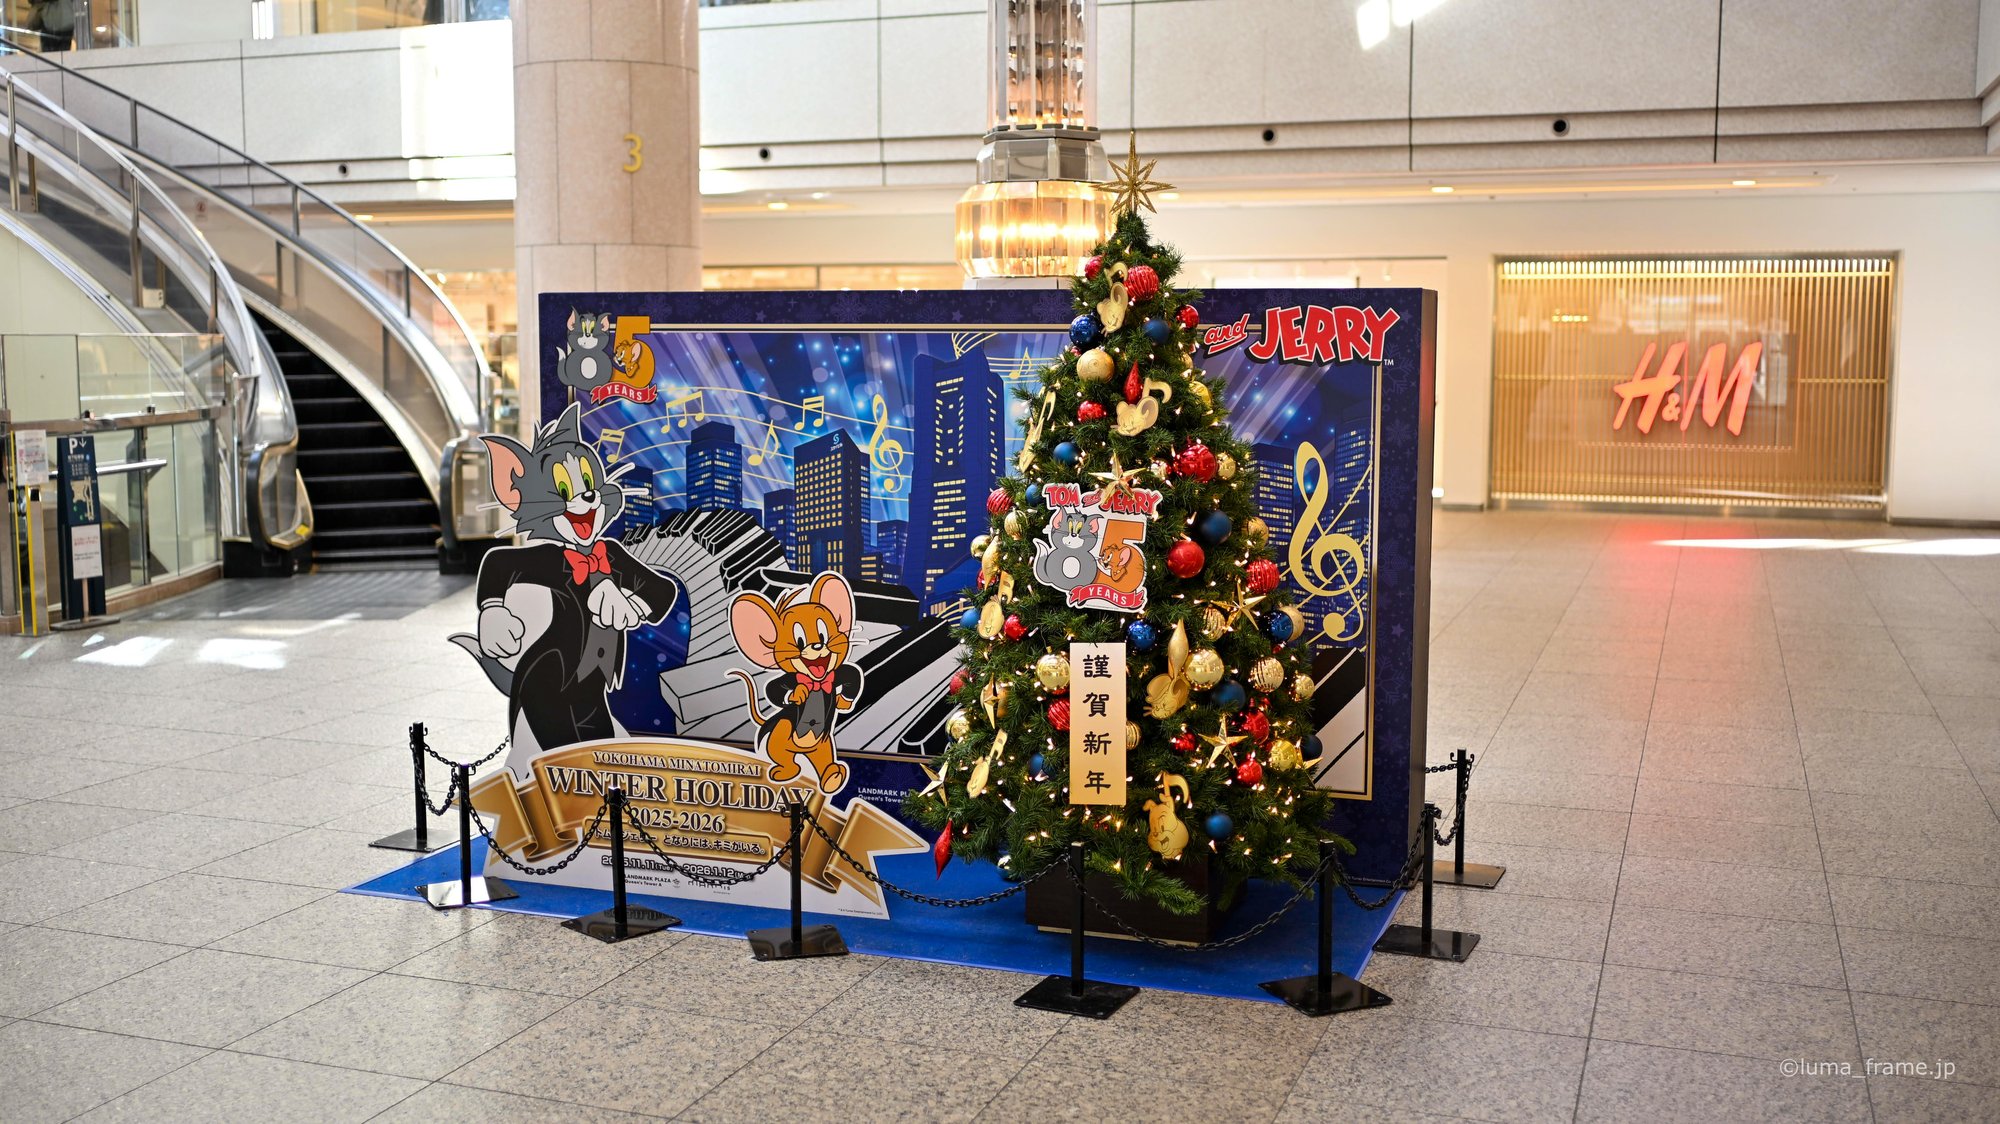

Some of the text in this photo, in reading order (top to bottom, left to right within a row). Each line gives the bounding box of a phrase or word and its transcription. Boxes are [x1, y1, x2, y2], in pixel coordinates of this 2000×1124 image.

[623, 133, 643, 172] 3
[1204, 313, 1250, 354] and
[1249, 305, 1400, 362] JERRY
[606, 384, 643, 401] YEARS
[1613, 341, 1763, 437] H&M
[69, 437, 78, 454] P
[1046, 485, 1080, 508] TOM
[1088, 586, 1127, 605] YEARS
[1082, 654, 1112, 794] 謹賀新年
[593, 751, 761, 776] YOKOHAMA MINATOMIRAI
[545, 765, 814, 812] WINTER HOLIDAY
[858, 787, 898, 796] LANDMARK
[663, 834, 766, 855] となりには、キミがいる。
